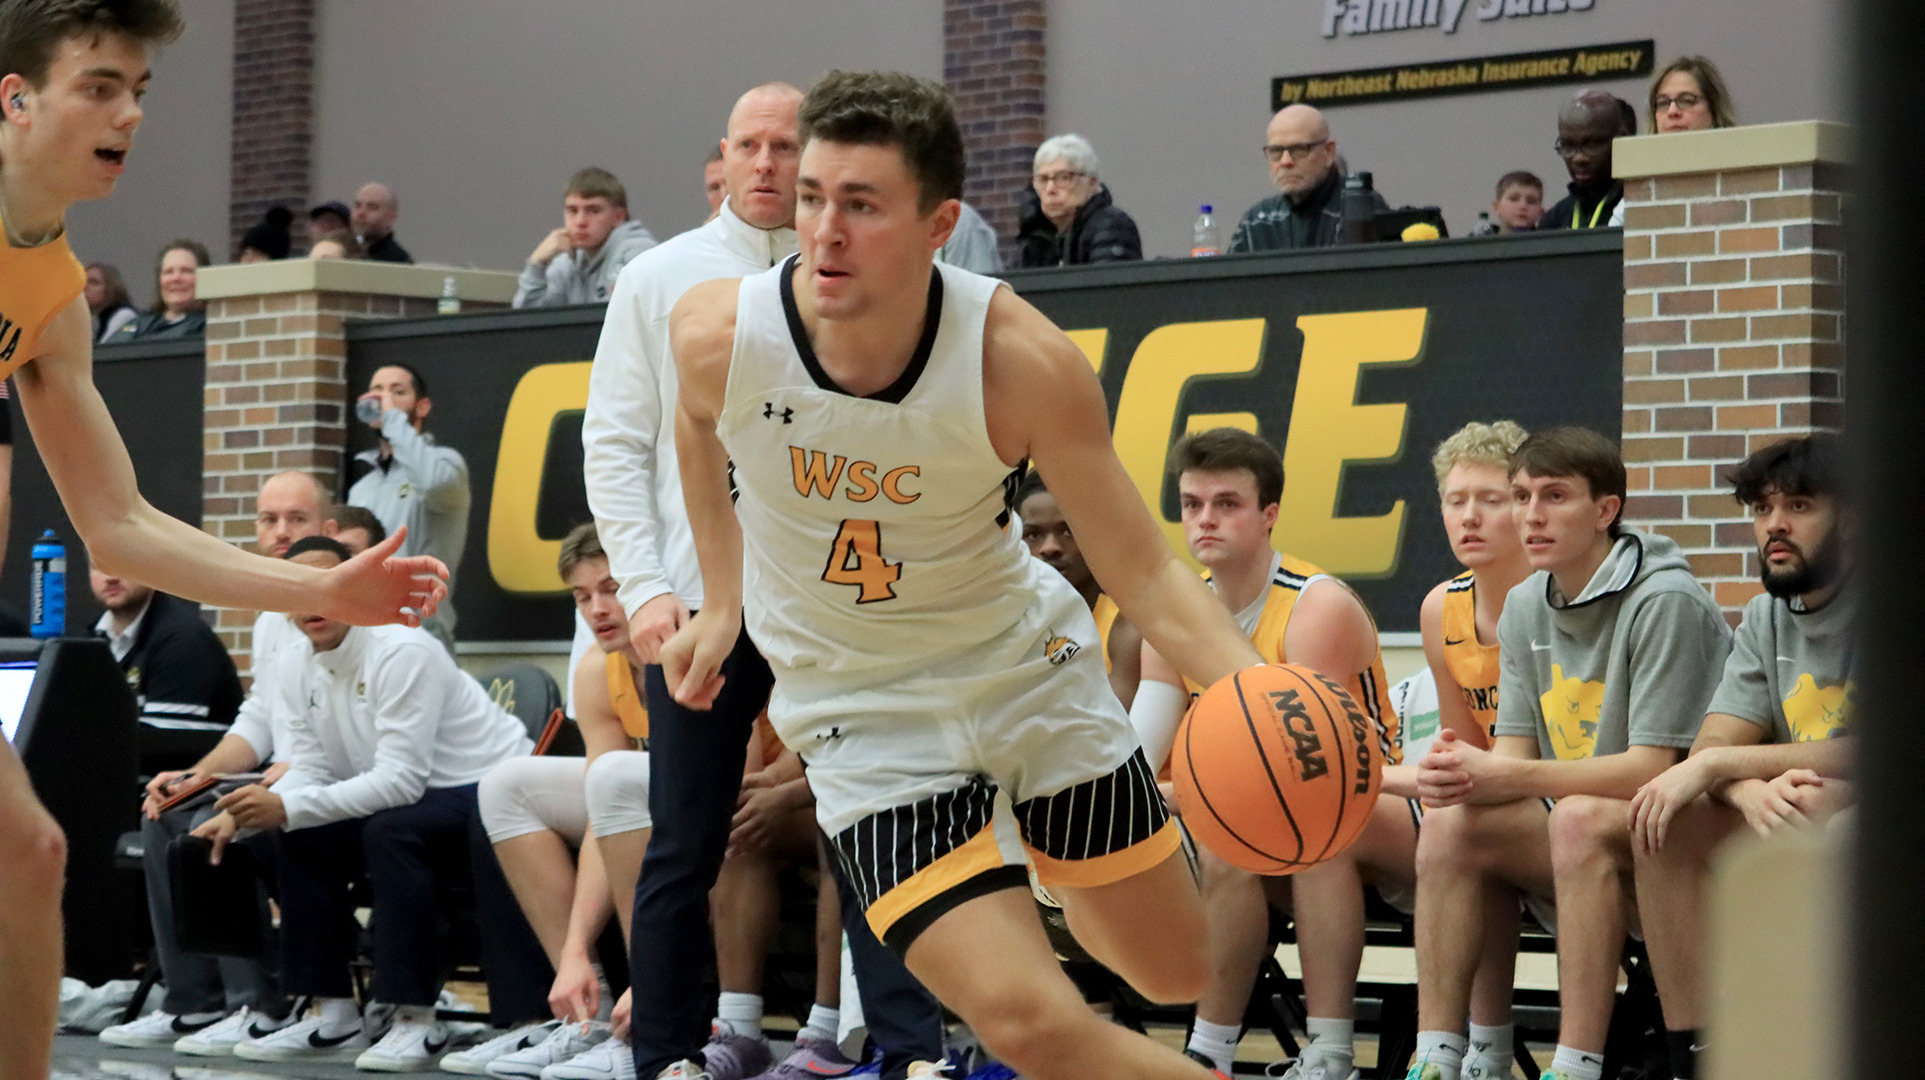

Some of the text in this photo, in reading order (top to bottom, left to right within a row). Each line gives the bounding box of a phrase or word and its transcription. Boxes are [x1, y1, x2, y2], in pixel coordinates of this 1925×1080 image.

[1281, 50, 1643, 103] by Northeast Nebraska Insurance Agency
[789, 445, 921, 504] WSC
[31, 560, 43, 625] POWERADE
[821, 519, 903, 604] 4
[1268, 688, 1329, 782] NCAA
[1313, 673, 1370, 795] Wilson
